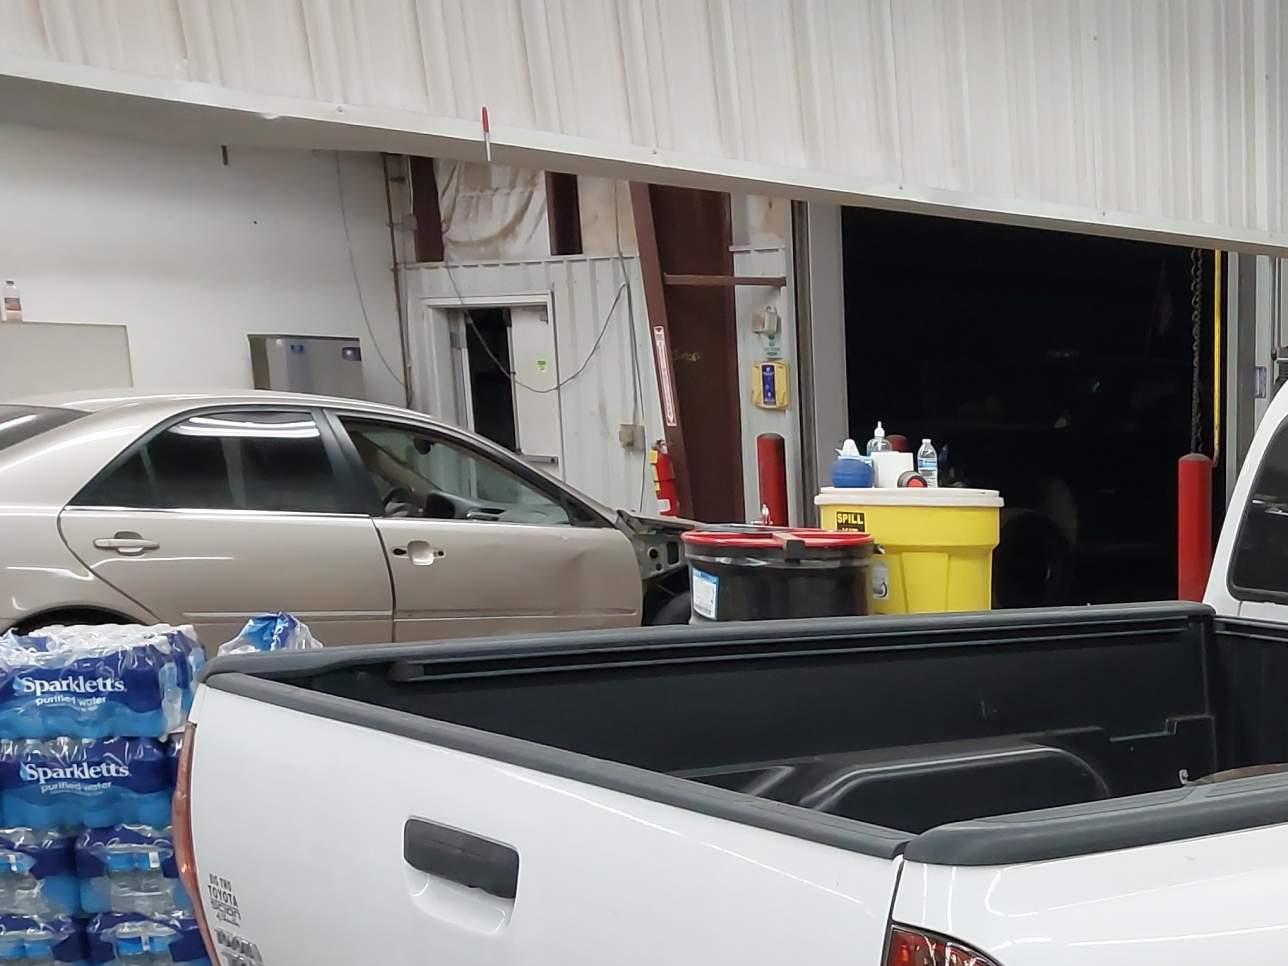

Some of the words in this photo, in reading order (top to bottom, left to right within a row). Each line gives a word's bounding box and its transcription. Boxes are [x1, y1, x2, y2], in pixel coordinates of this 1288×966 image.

[837, 513, 864, 525] SPILL
[23, 676, 126, 697] Sparkletts
[36, 695, 76, 706] purified
[78, 697, 107, 706] water
[25, 762, 130, 784] Sparkletts
[41, 781, 81, 795] purified
[83, 781, 112, 792] water
[208, 885, 239, 908] TOYOTA
